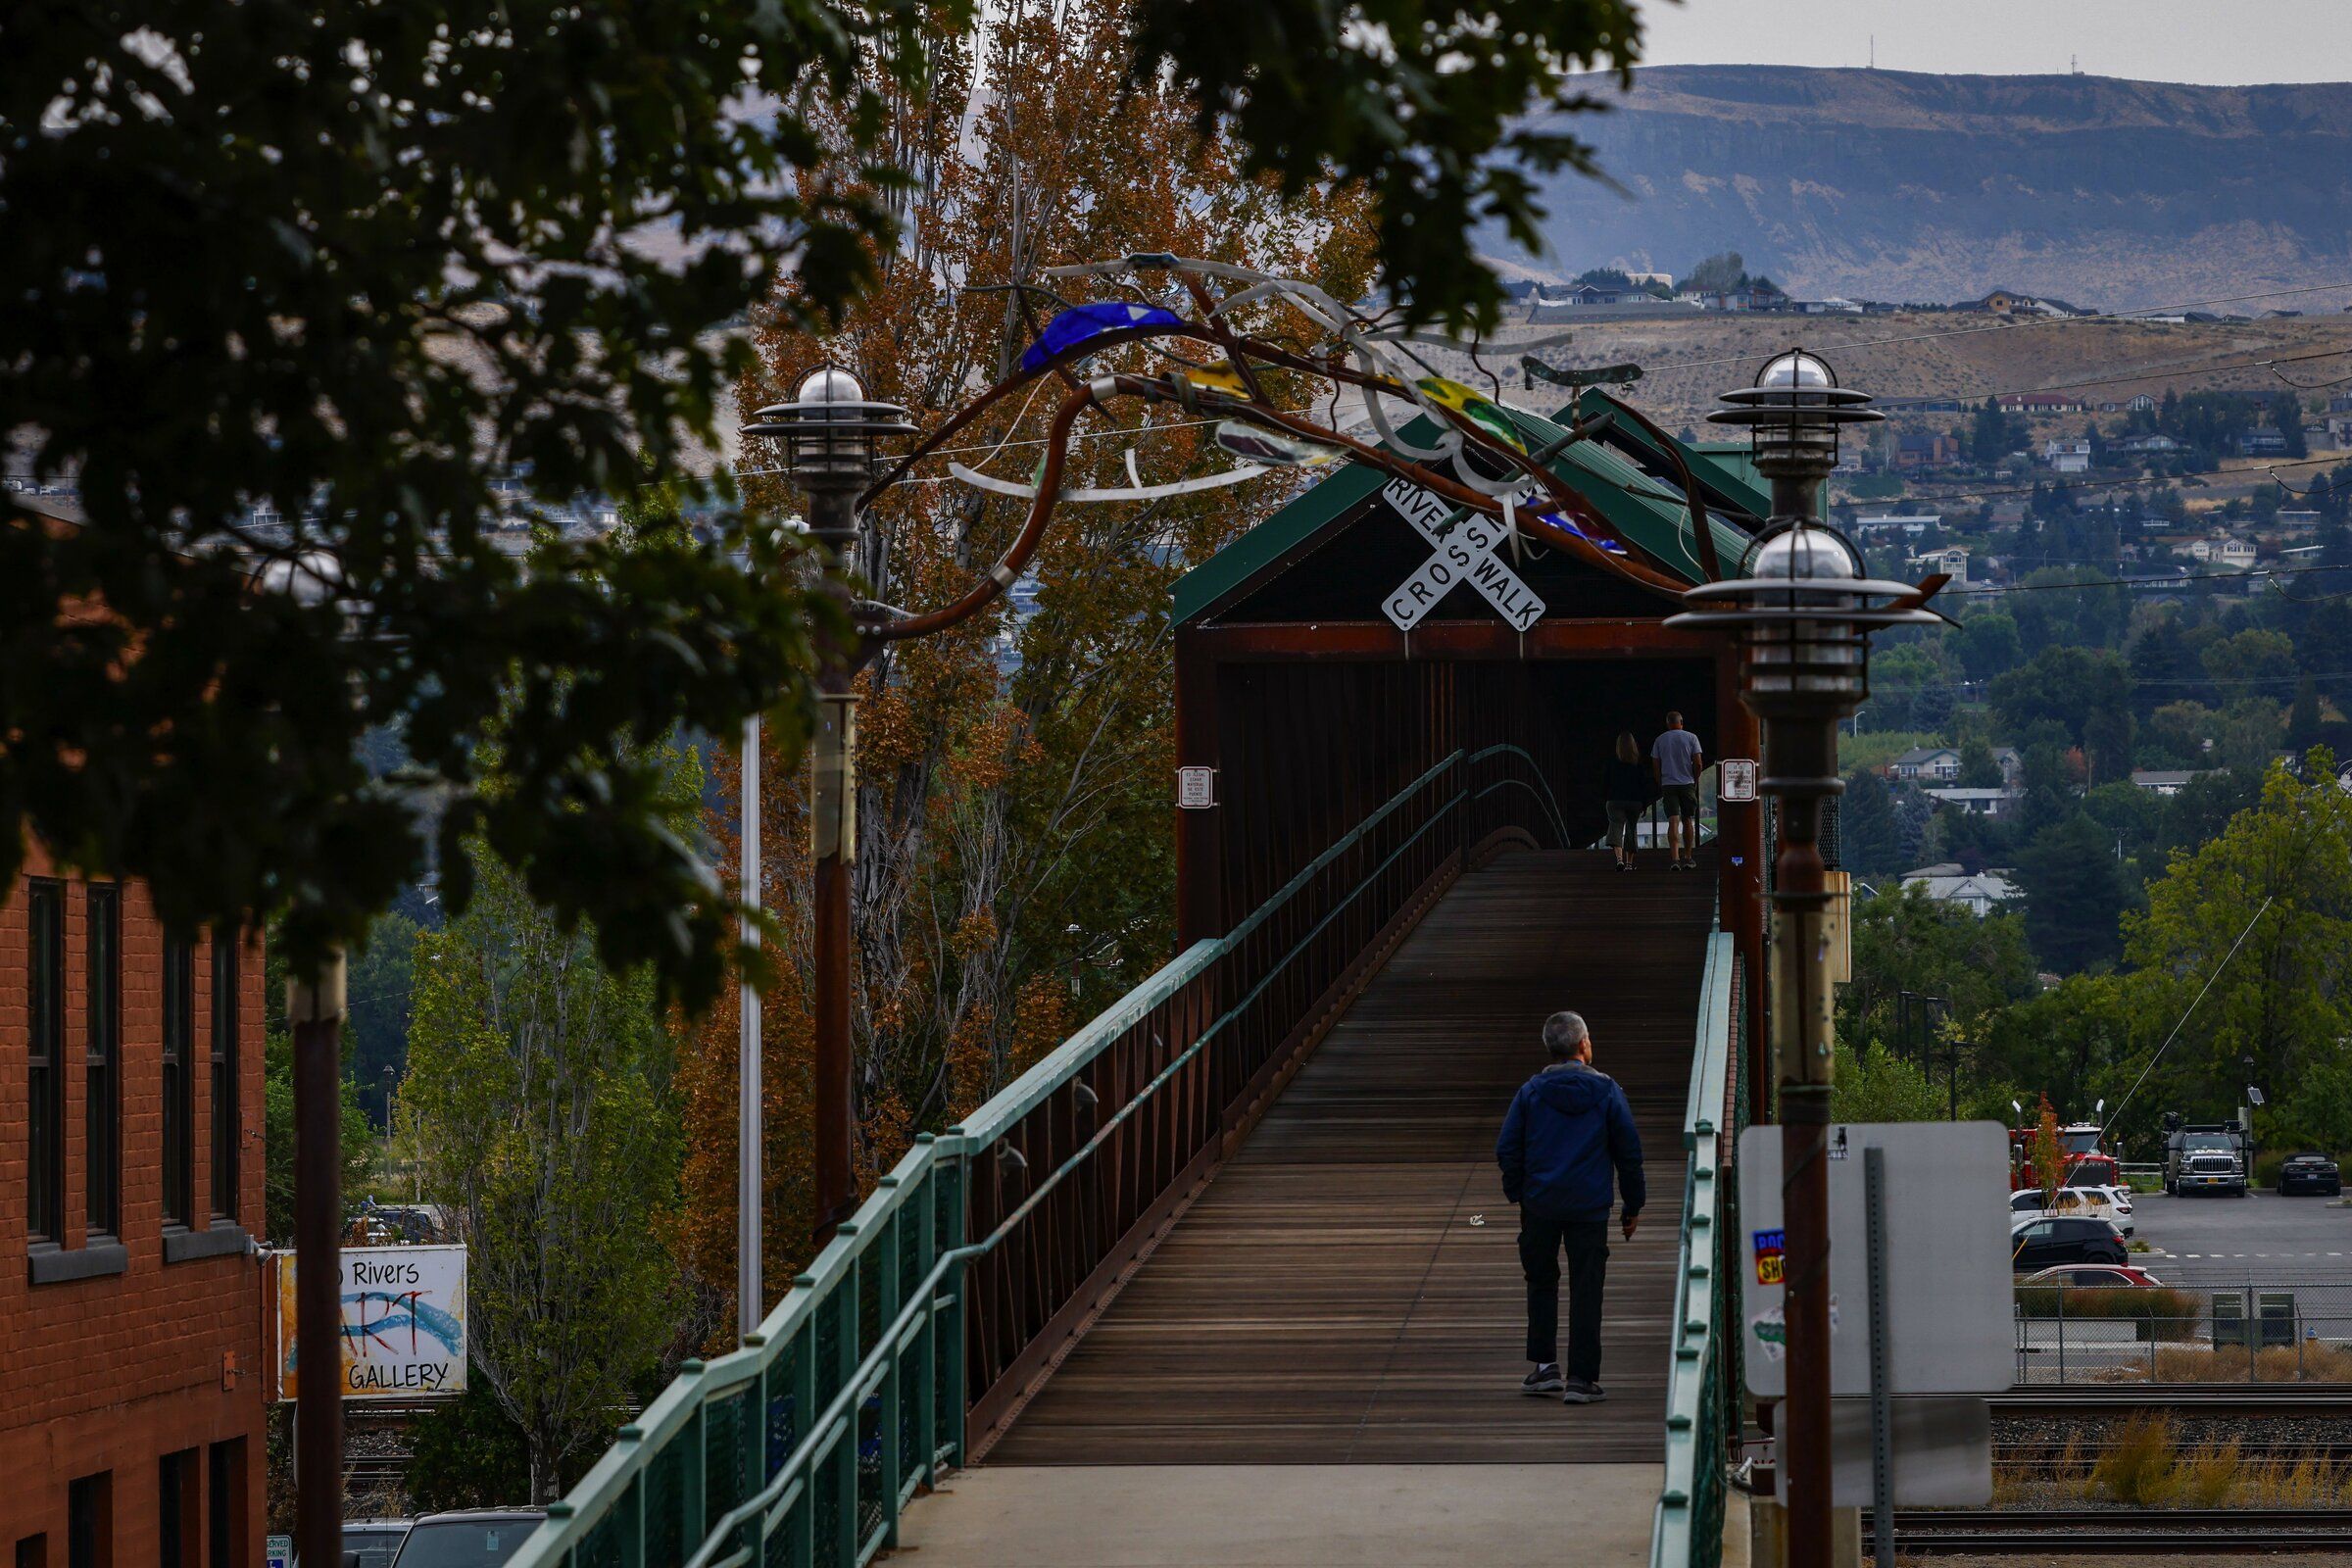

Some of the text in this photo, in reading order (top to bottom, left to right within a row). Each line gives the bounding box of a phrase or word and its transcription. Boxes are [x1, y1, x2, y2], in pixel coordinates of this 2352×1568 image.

[1388, 478, 1541, 627] RIVER WALK
[353, 1260, 420, 1286] Rivers
[349, 1362, 449, 1390] GALLERY
